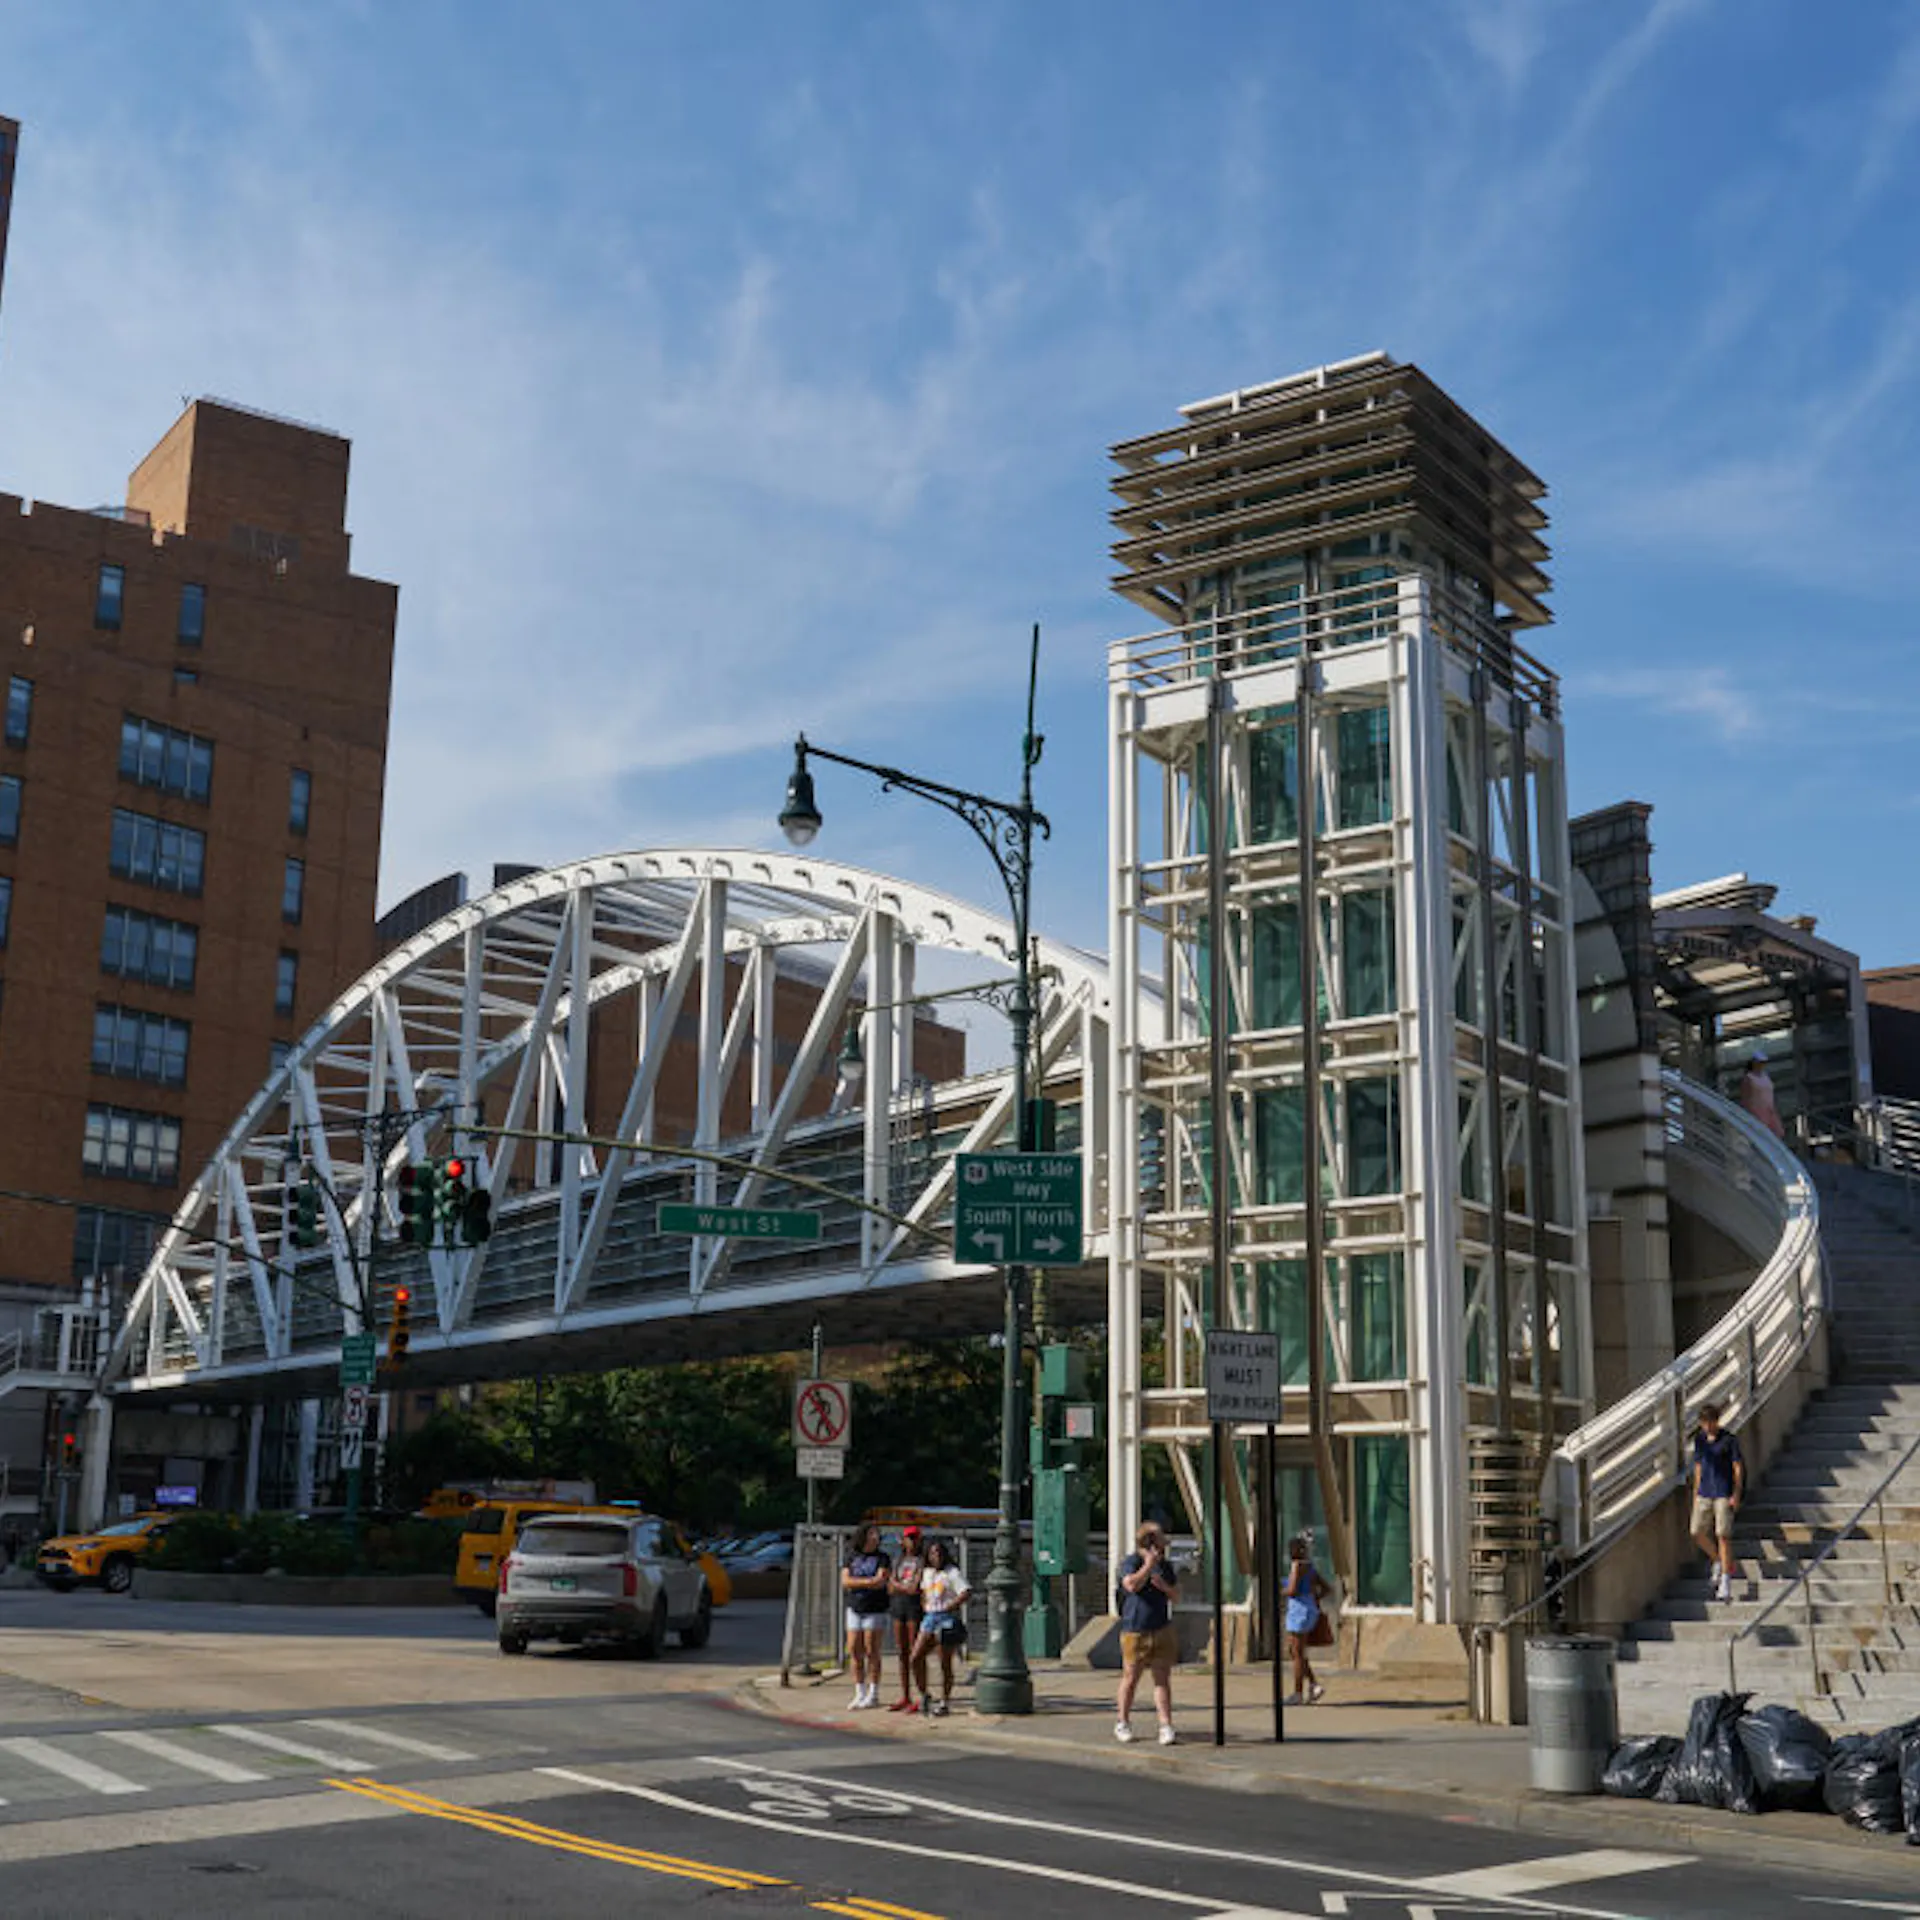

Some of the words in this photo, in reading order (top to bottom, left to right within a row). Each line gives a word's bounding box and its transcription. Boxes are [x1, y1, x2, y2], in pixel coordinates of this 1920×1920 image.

[992, 1159, 1033, 1177] West
[1040, 1160, 1075, 1178] Side
[1012, 1181, 1052, 1201] Hwy
[697, 1212, 750, 1232] West
[756, 1214, 782, 1234] St
[963, 1206, 1012, 1225] South
[1023, 1207, 1075, 1226] North
[1224, 1366, 1263, 1385] MUST
